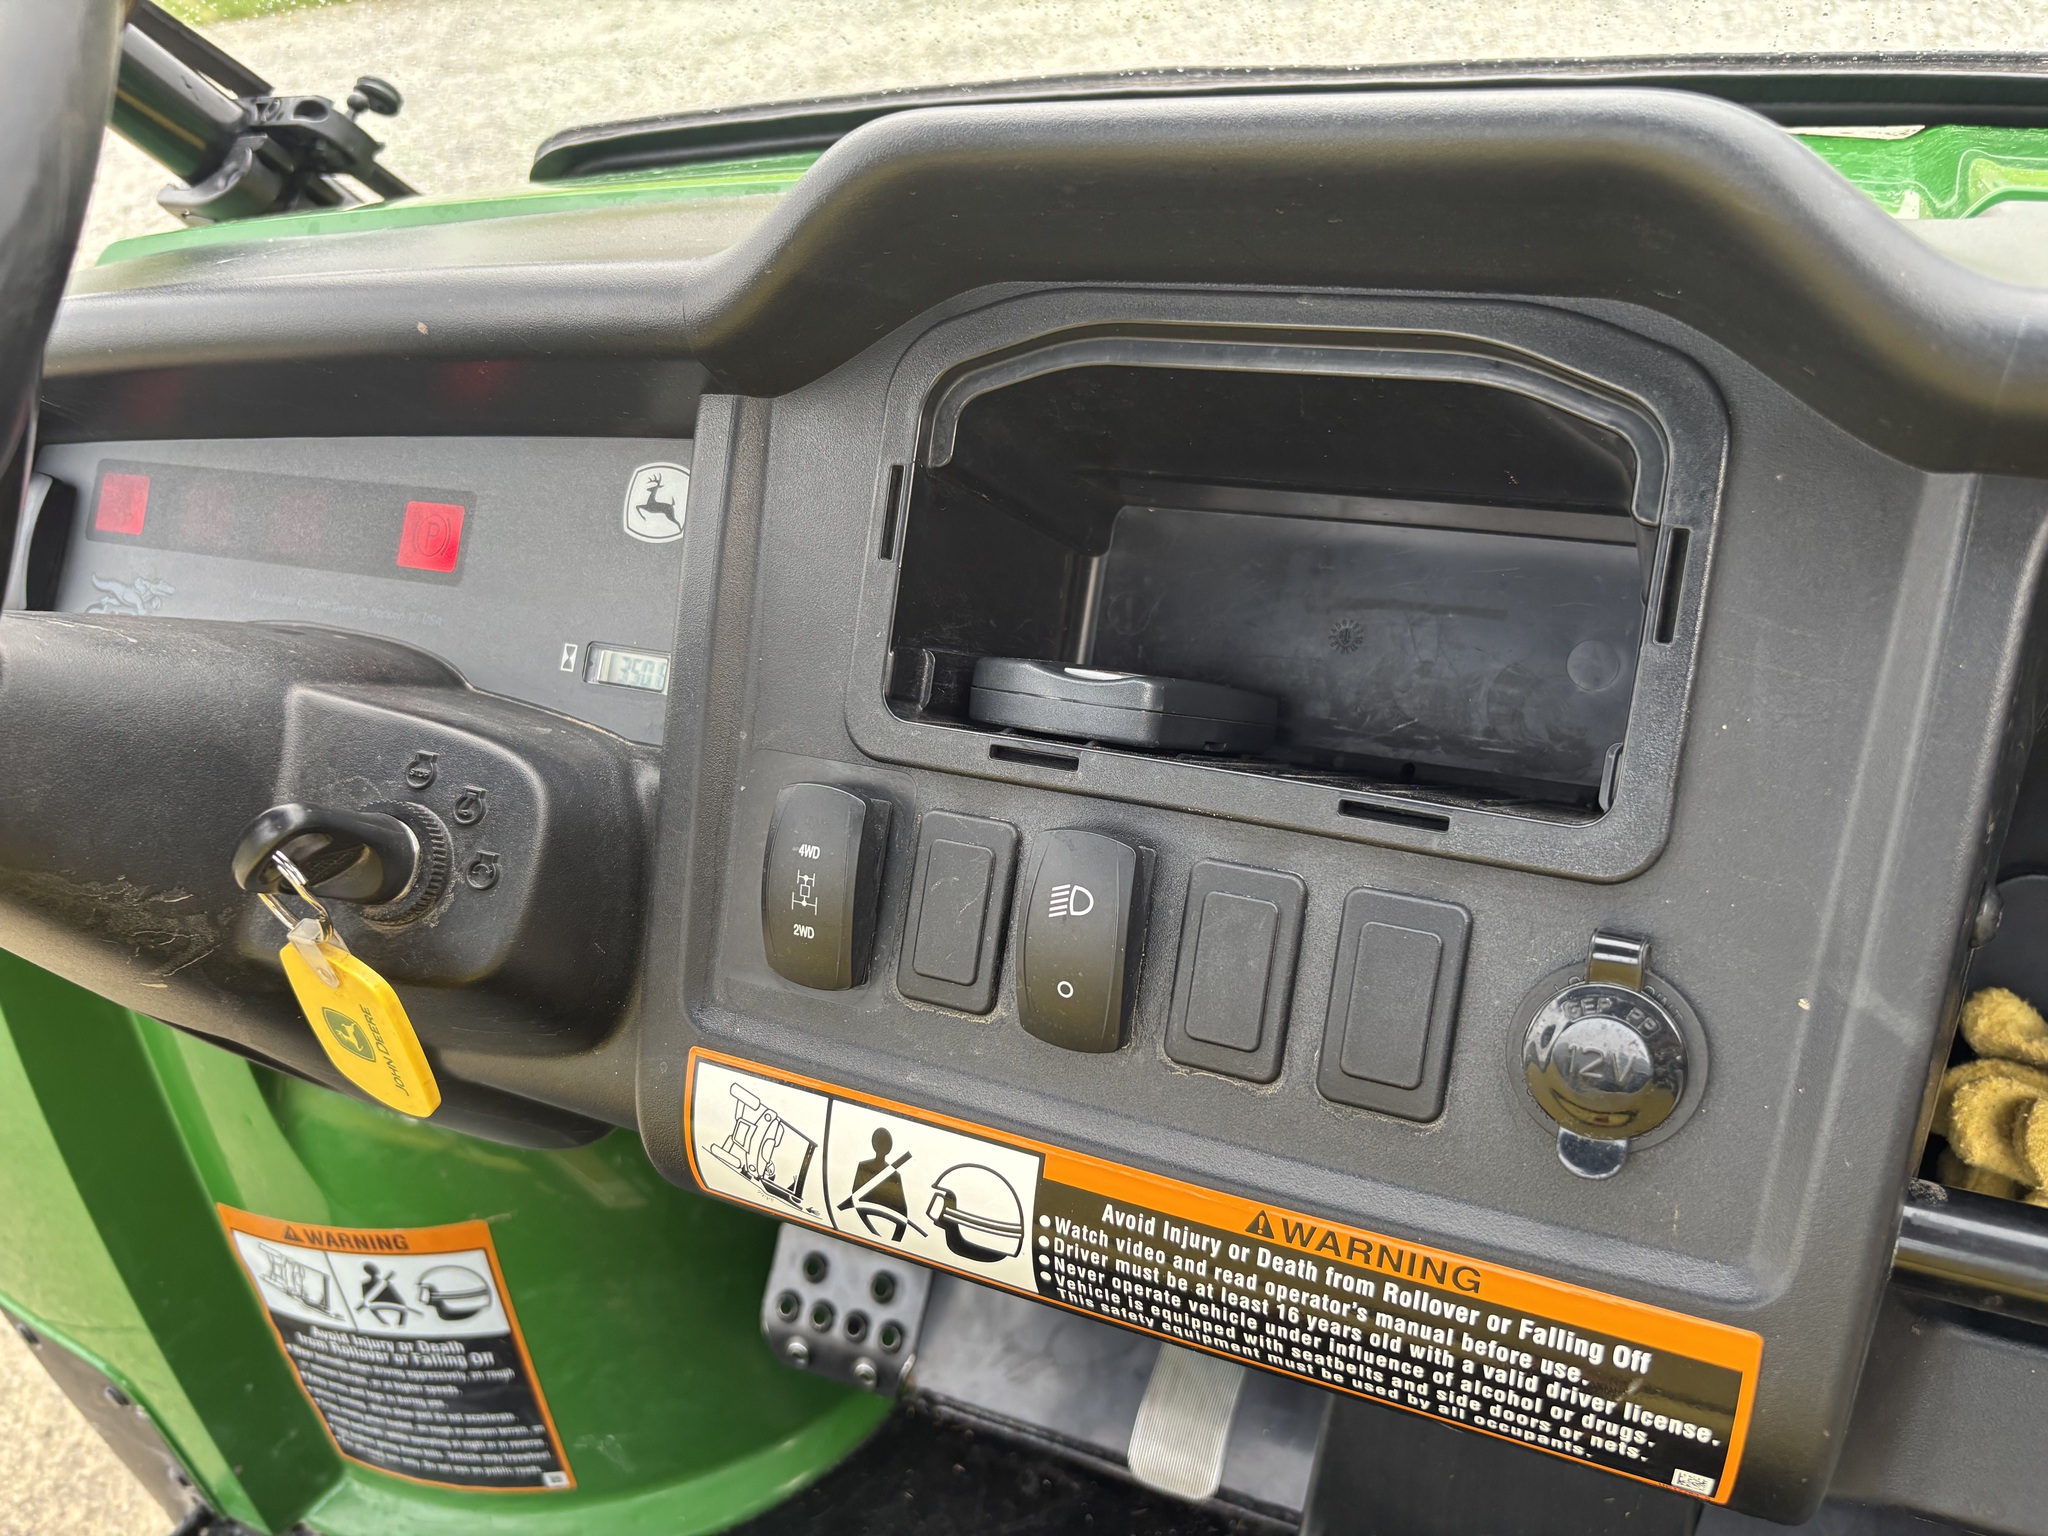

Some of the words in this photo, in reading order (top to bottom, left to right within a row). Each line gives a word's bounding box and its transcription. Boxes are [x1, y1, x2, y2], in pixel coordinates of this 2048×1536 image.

[799, 844, 820, 860] 4WD
[793, 924, 815, 939] 2WD
[359, 1004, 390, 1055] DEERE
[383, 1056, 409, 1096] JOHN
[1568, 1043, 1636, 1086] 12V
[303, 1228, 408, 1251] WARNING
[1282, 1218, 1482, 1294] WARNING
[1054, 1216, 1109, 1248] Watch
[1116, 1237, 1166, 1265] video
[1173, 1252, 1207, 1277] and
[1214, 1265, 1257, 1291] read
[1265, 1281, 1368, 1322] operator's
[1375, 1313, 1454, 1346] manual
[1461, 1333, 1532, 1368] before
[1541, 1358, 1589, 1386] use.
[1101, 1204, 1155, 1237] Avoid
[1163, 1220, 1222, 1258] Injury
[1228, 1243, 1250, 1262] or
[1257, 1248, 1318, 1283] Death
[1325, 1266, 1375, 1298] from
[1382, 1282, 1480, 1326] Rollover
[1487, 1312, 1512, 1335] or
[1519, 1319, 1605, 1366] Falling
[1613, 1345, 1652, 1374] Off
[294, 1331, 328, 1352] from
[328, 1341, 390, 1363] Rollover
[391, 1353, 409, 1367] or
[410, 1352, 468, 1370] Falling
[468, 1352, 494, 1368] Off
[310, 1326, 350, 1344] Avoid
[350, 1334, 394, 1353] Injury
[396, 1342, 414, 1353] or
[415, 1340, 465, 1355] Death
[1053, 1238, 1109, 1267] Driver
[1115, 1257, 1159, 1282] must
[1167, 1271, 1188, 1290] be
[1196, 1281, 1214, 1298] at
[1221, 1288, 1269, 1317] least
[1277, 1304, 1298, 1324] 16
[1306, 1316, 1361, 1343] years
[1369, 1333, 1401, 1352] old
[1409, 1338, 1454, 1368] with
[1462, 1356, 1474, 1374] a
[1482, 1366, 1538, 1392] valid
[1546, 1381, 1617, 1415] driver
[1624, 1402, 1720, 1446] license.
[1053, 1256, 1104, 1284] Never
[1112, 1274, 1181, 1308] operate
[1188, 1298, 1258, 1329] vehicle
[1265, 1320, 1321, 1348] under
[1329, 1338, 1424, 1379] influence
[1432, 1370, 1454, 1389] of
[1461, 1378, 1542, 1412] alcohol
[1551, 1405, 1574, 1422] or
[1582, 1412, 1655, 1447] drugs.
[1054, 1273, 1121, 1303] Vehicle
[1128, 1295, 1143, 1310] is
[1151, 1304, 1236, 1345] equipped
[1243, 1331, 1284, 1354] with
[1291, 1346, 1384, 1381] seatbelts
[1392, 1376, 1428, 1398] and
[1436, 1388, 1482, 1412] side
[1489, 1402, 1551, 1431] doors
[1559, 1424, 1583, 1441] or
[1590, 1432, 1648, 1461] nets.
[1057, 1288, 1094, 1308] This
[1101, 1302, 1154, 1328] safety
[1162, 1321, 1261, 1359] equipment
[1268, 1352, 1314, 1374] must
[1322, 1367, 1344, 1383] be
[1352, 1378, 1400, 1400] used
[1408, 1392, 1430, 1409] by
[1438, 1403, 1465, 1420] all
[1474, 1414, 1592, 1459] occupants.
